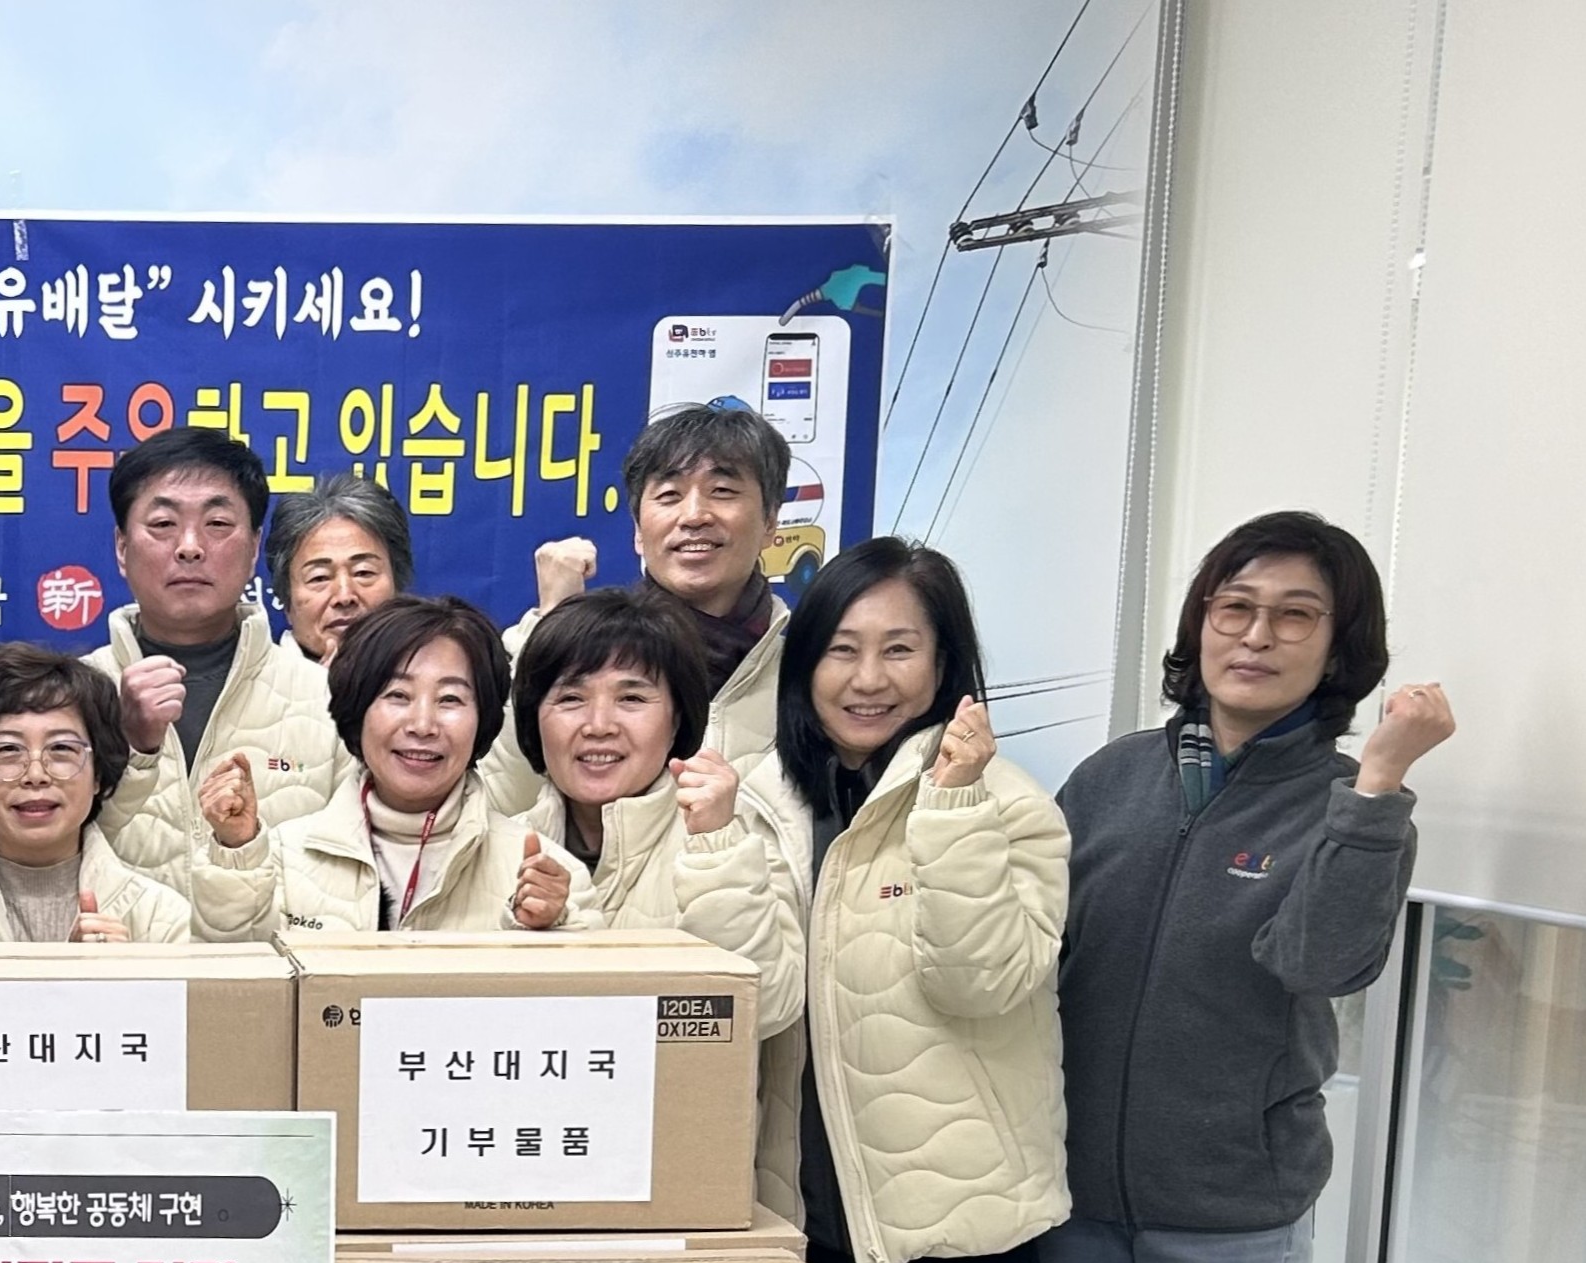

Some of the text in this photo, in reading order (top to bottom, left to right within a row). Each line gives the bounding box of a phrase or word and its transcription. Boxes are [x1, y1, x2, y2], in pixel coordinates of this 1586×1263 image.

[188, 265, 423, 340] 시키세요!
[339, 383, 619, 517] 있습니다.
[662, 999, 713, 1017] 120EA
[10, 1191, 81, 1226] 행복한
[86, 1192, 152, 1226] 공동체
[158, 1192, 203, 1226] 구현
